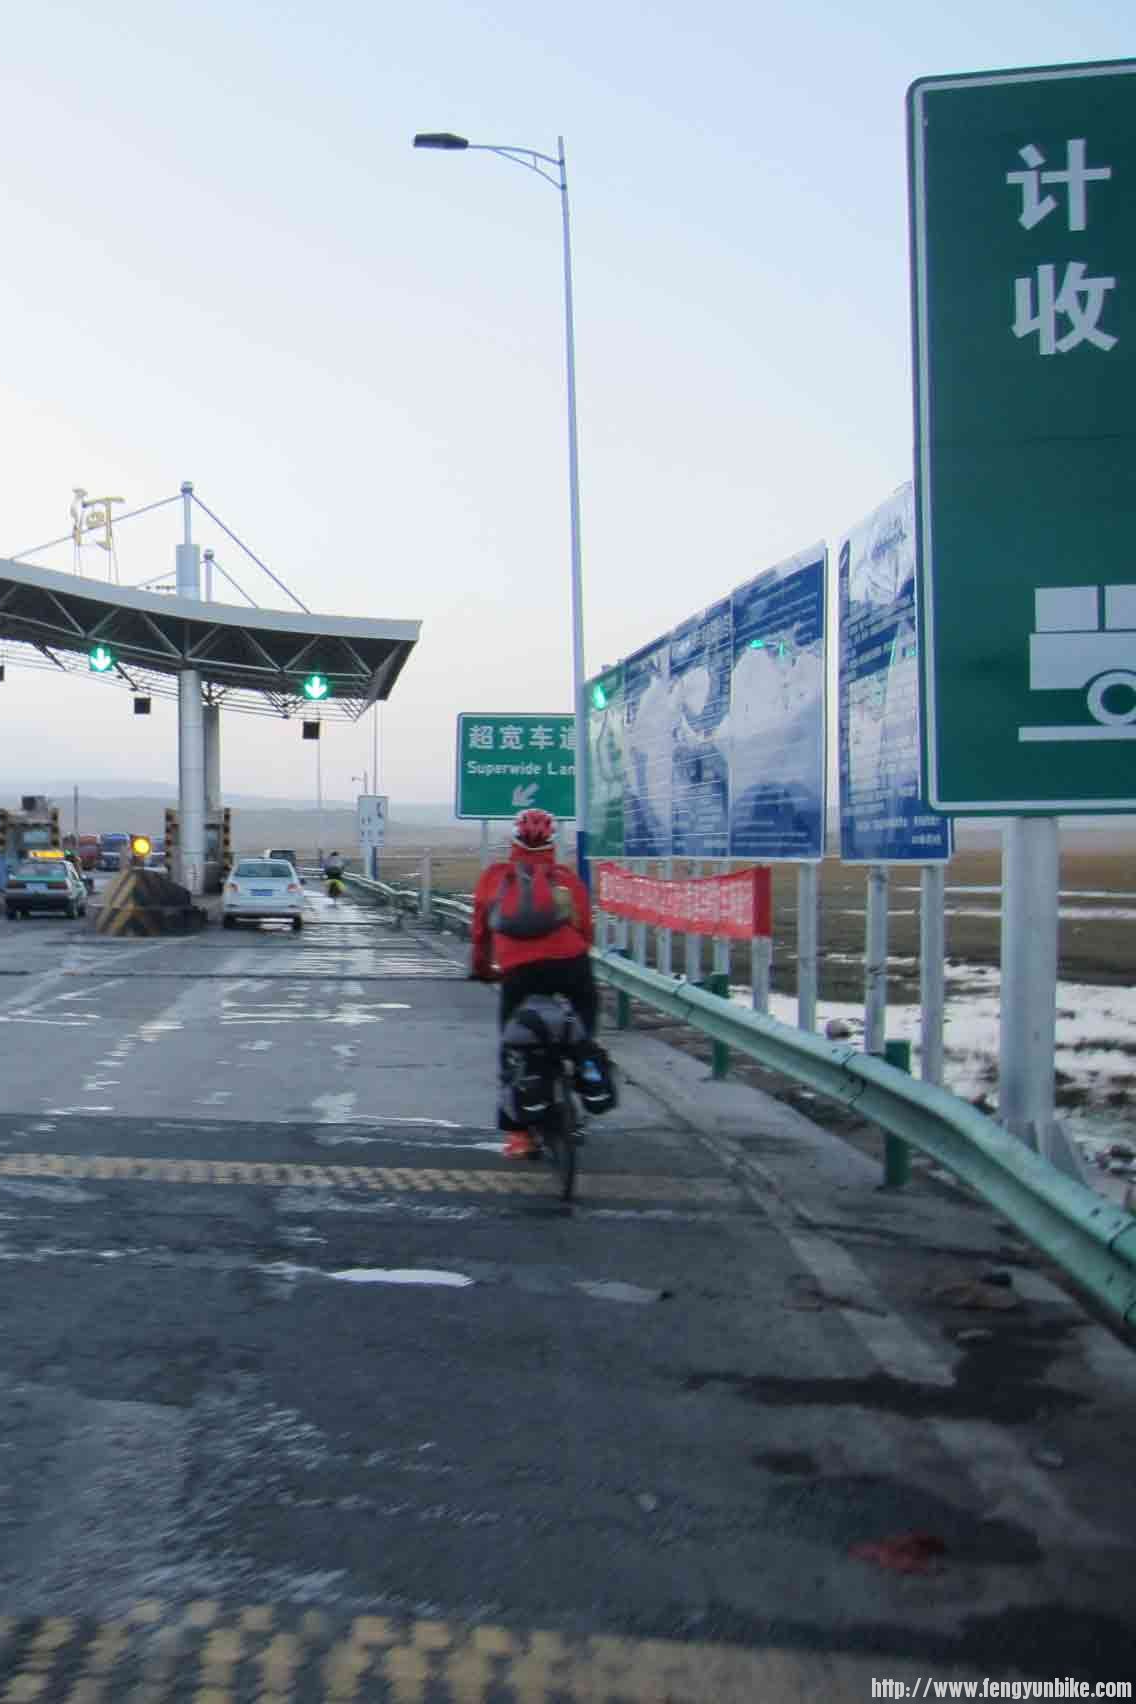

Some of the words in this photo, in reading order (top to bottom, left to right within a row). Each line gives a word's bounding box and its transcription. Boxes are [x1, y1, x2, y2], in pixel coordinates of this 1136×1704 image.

[1006, 138, 1112, 231] 计
[1011, 260, 1119, 356] 收
[468, 725, 576, 750] 超宽车道
[466, 760, 542, 776] Superwide
[547, 761, 576, 775] Lan
